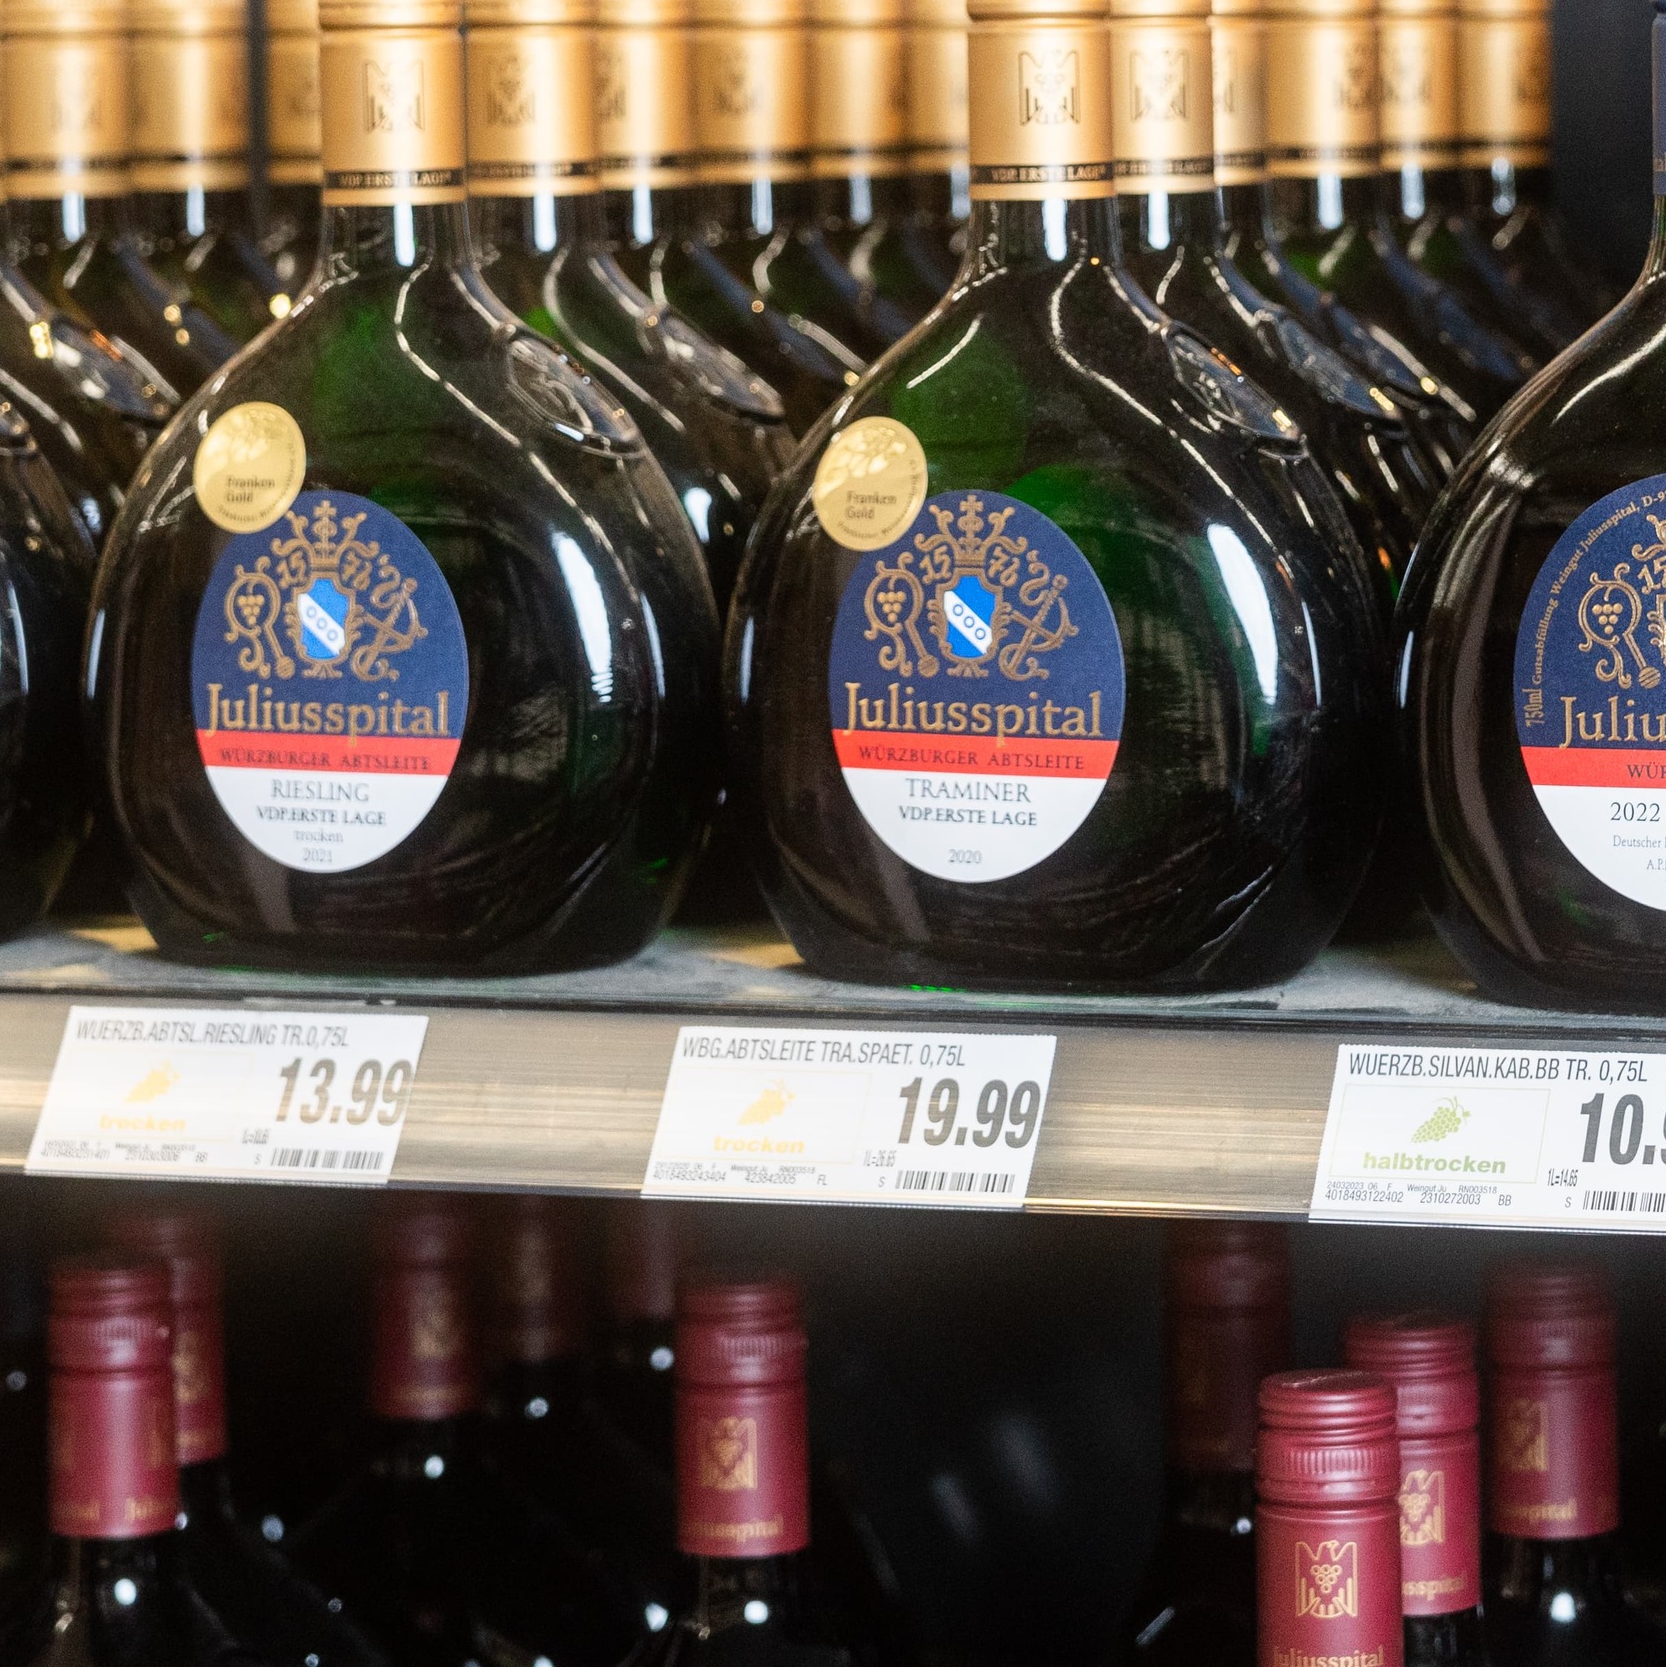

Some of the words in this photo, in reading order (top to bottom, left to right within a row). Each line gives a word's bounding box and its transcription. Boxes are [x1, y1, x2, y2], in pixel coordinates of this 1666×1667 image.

[847, 491, 897, 505] Franken
[1532, 599, 1559, 685] Gutsabfüllung
[1550, 550, 1584, 595] Weingut
[1579, 501, 1641, 552] Juliusspital,
[205, 683, 451, 747] Juliusspital
[842, 681, 1104, 748] Juliusspital
[1522, 688, 1545, 728] 750ml
[341, 755, 431, 770] ABTSLEITE
[859, 745, 978, 765] WÜRZBURGER
[987, 753, 1084, 770] ABTSLEITE
[271, 779, 370, 802] RIESLING
[905, 778, 1031, 803] TRAMINER
[343, 810, 386, 825] LAGE
[991, 811, 1037, 826] LAGE
[1610, 801, 1661, 822] 2022
[1613, 834, 1661, 848] Deutscher
[948, 849, 982, 864] 2020
[681, 1037, 817, 1063] WBG.ABTSLEITE
[821, 1041, 914, 1067] TRA.SPAET.
[920, 1044, 966, 1068] 0,75L
[1349, 1052, 1559, 1081] WUERZB.SILVAN.KAB.BB
[1566, 1058, 1593, 1082] TR.
[1599, 1060, 1648, 1086] 0,75L
[276, 1056, 413, 1126] 13.99
[99, 1113, 186, 1132] trocken
[897, 1076, 1042, 1149] 19.99
[713, 1134, 805, 1155] trocken
[1362, 1151, 1507, 1175] halbtrocken
[1326, 1181, 1364, 1191] 24032023
[1407, 1183, 1436, 1193] Weingut
[1437, 1185, 1447, 1193] Ju
[1458, 1185, 1497, 1194] RN003518
[1547, 1168, 1579, 1187] 1L=14.65
[1325, 1189, 1404, 1203] 4018493122402
[1420, 1191, 1481, 1205] 2310272003
[1497, 1194, 1512, 1207] BB
[1565, 1196, 1572, 1208] S
